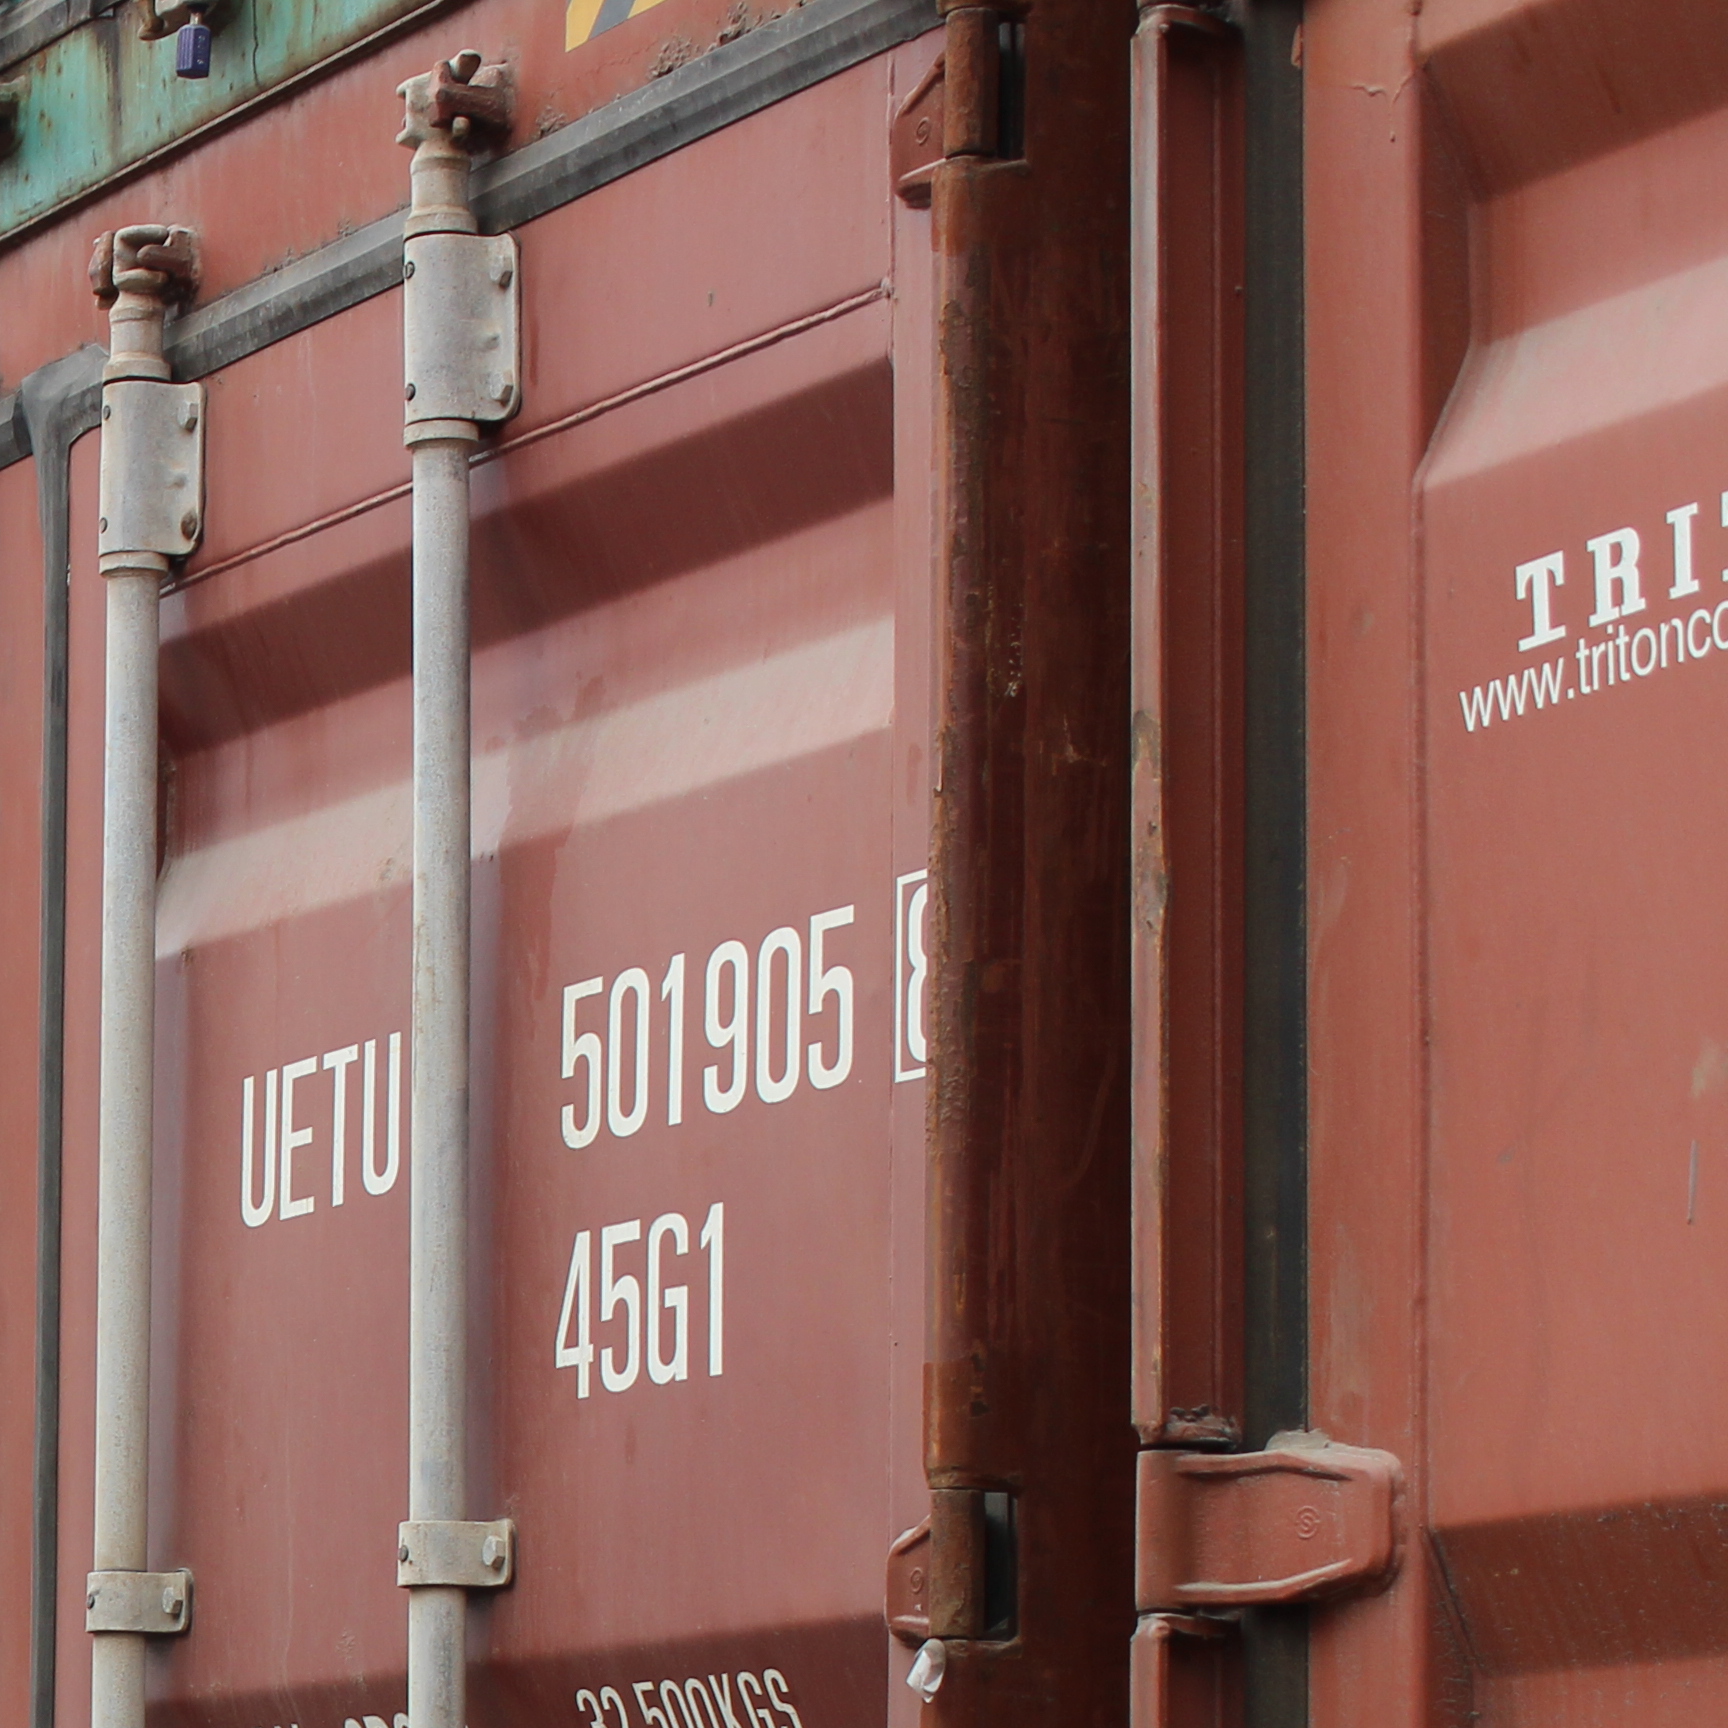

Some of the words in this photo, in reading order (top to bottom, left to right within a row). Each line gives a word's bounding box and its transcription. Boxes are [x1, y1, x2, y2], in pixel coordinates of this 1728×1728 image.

[1516, 490, 1728, 652] TRI
[560, 905, 856, 1150] 501905
[241, 1032, 402, 1228] UETU
[554, 1202, 726, 1400] 45G1
